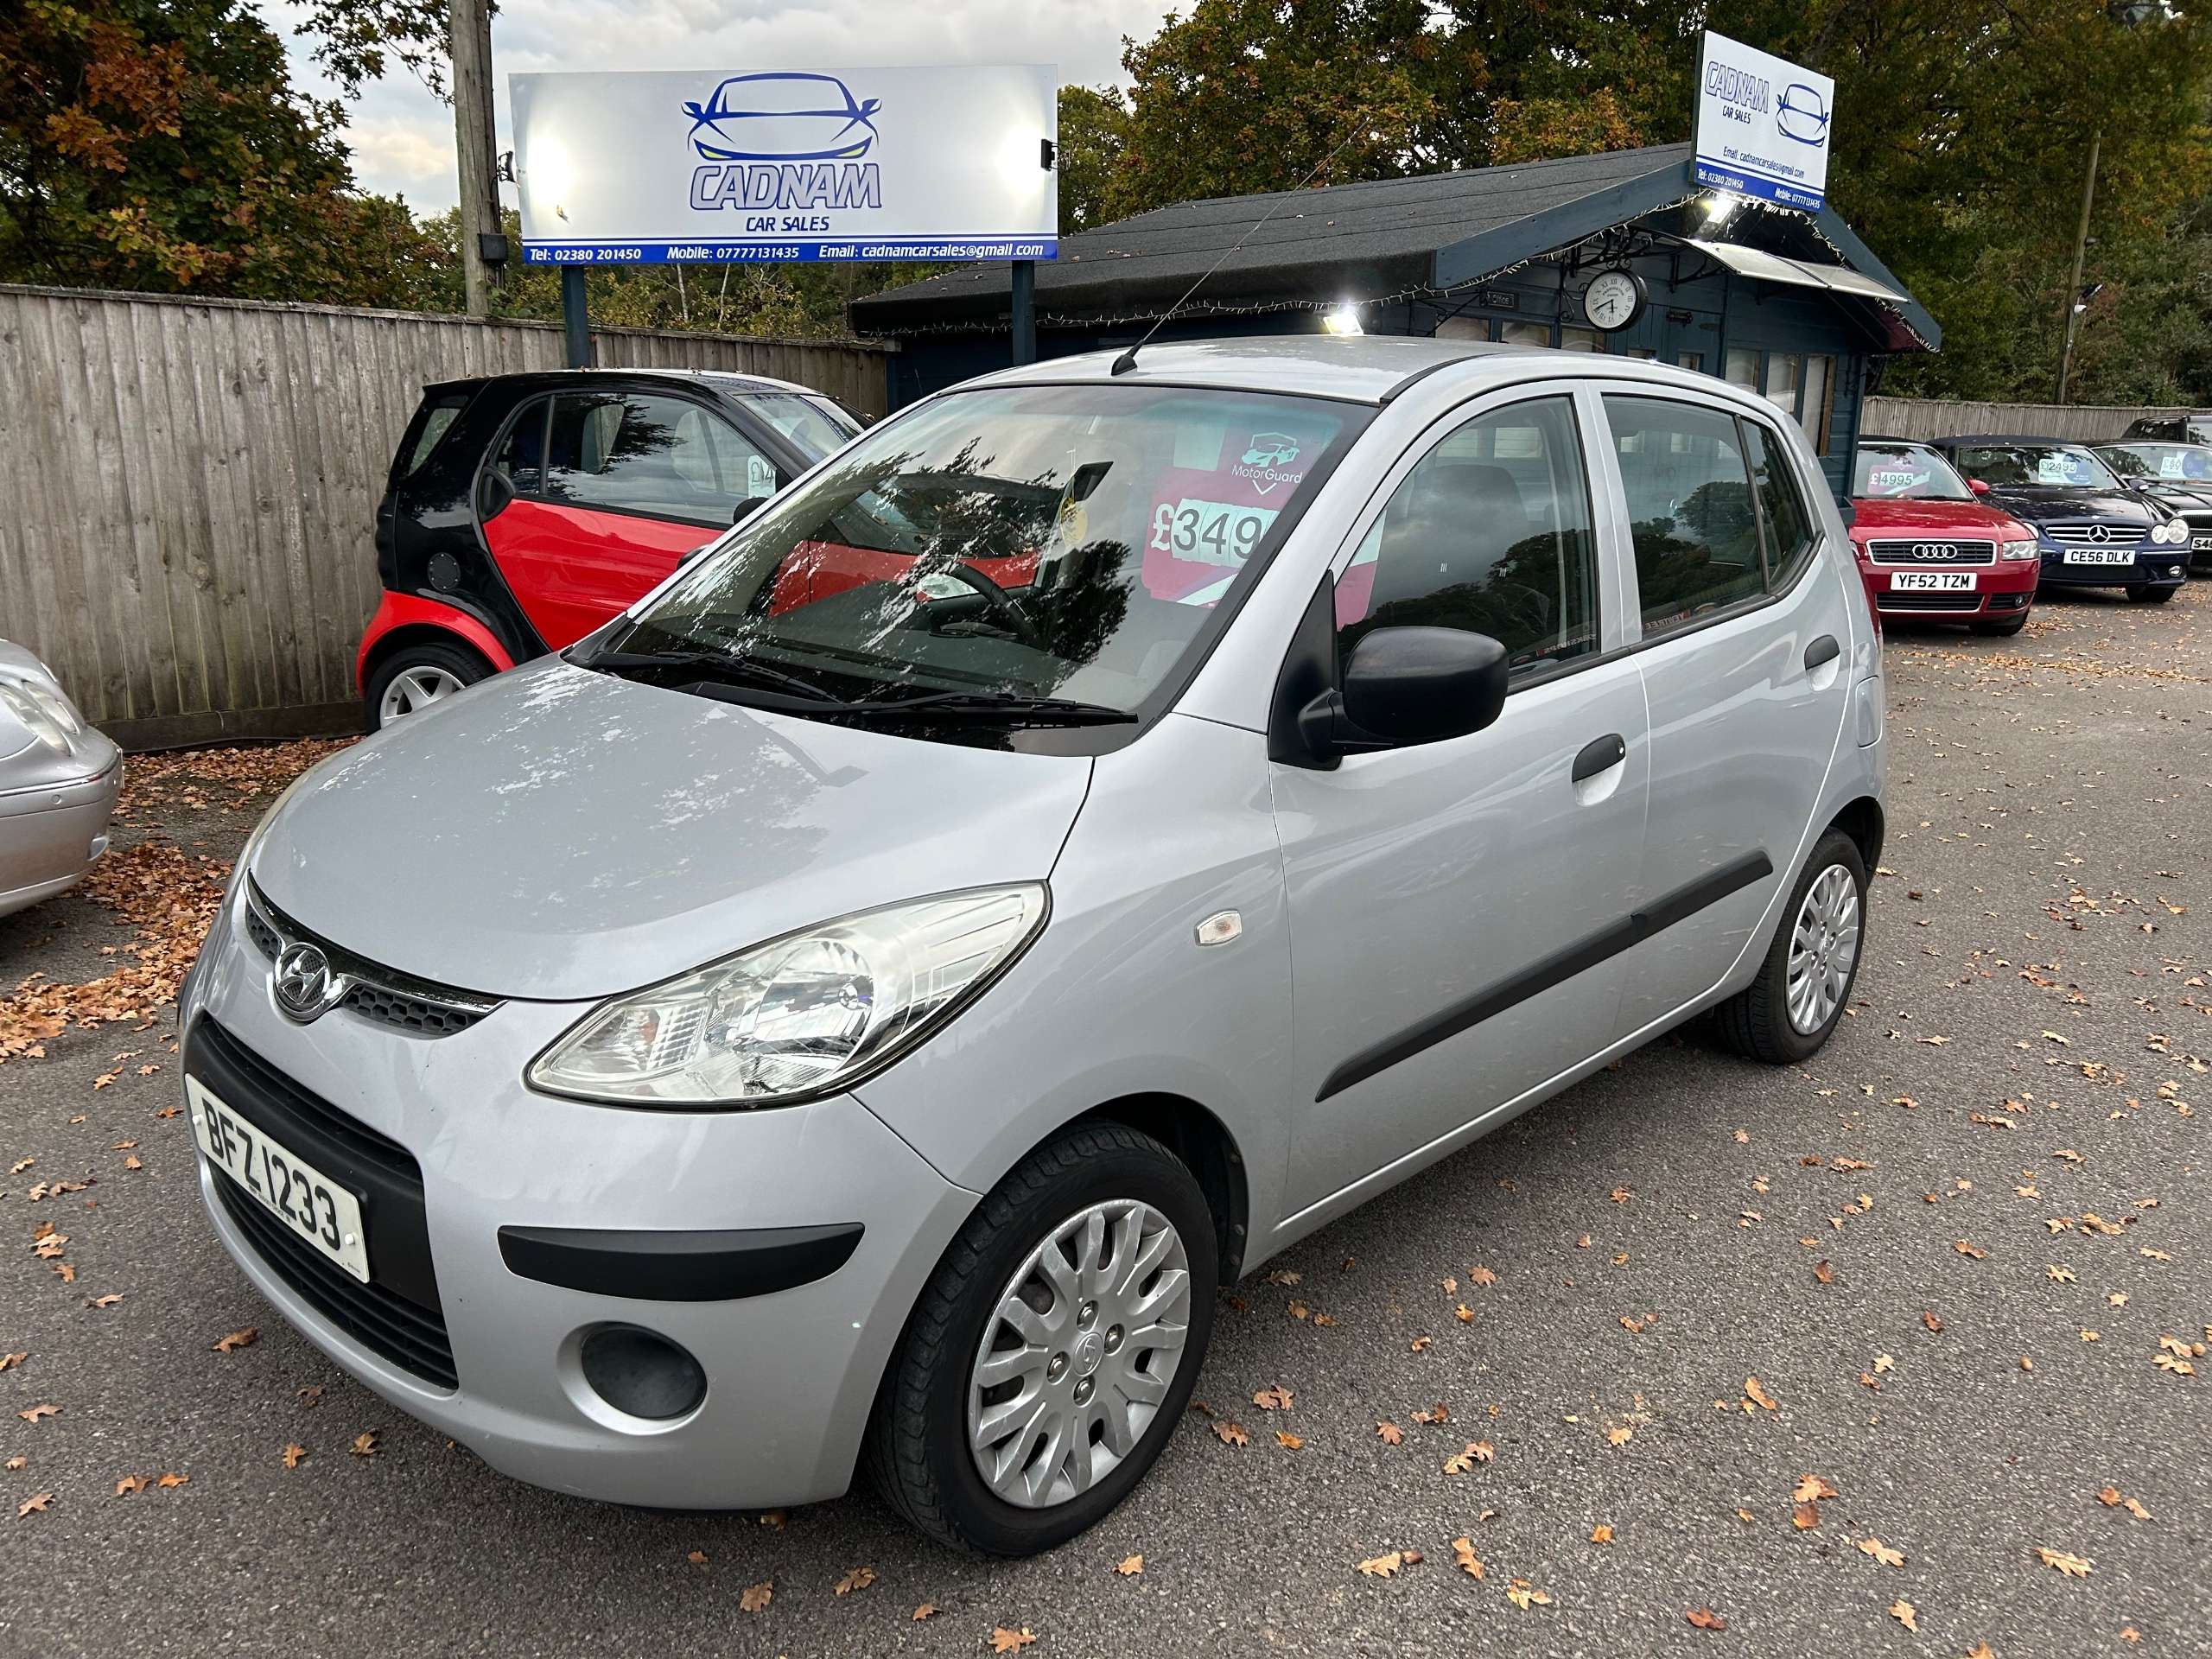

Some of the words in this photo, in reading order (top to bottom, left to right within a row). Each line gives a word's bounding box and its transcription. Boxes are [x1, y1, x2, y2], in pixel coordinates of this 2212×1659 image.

[1705, 60, 1770, 114] CADNAM
[1722, 105, 1733, 119] CAR
[1734, 109, 1751, 124] SALES
[1723, 146, 1738, 161] Email:
[690, 162, 882, 210] CADNAM
[1698, 168, 1707, 181] Tel:
[1707, 172, 1725, 185] 02380
[1725, 176, 1744, 189] 201450
[1774, 187, 1792, 201] Mobile:
[746, 216, 776, 232] CAR
[780, 216, 830, 232] SALES
[530, 248, 551, 260] Tel:
[555, 248, 593, 261] 02380
[596, 248, 641, 260] 201450
[666, 246, 713, 260] Mobile:
[716, 247, 800, 259] 07777131435
[819, 245, 858, 257] Email:
[861, 243, 1044, 259] cadnamcarsales@gmail.com
[1231, 464, 1303, 484] MotorGuard
[1869, 472, 1913, 486] £4995
[2071, 550, 2103, 563] CE56
[2107, 551, 2131, 563] DLK
[1898, 575, 1937, 588] YF52
[1942, 575, 1970, 588] TZM
[200, 1096, 341, 1251] BFZ1233
